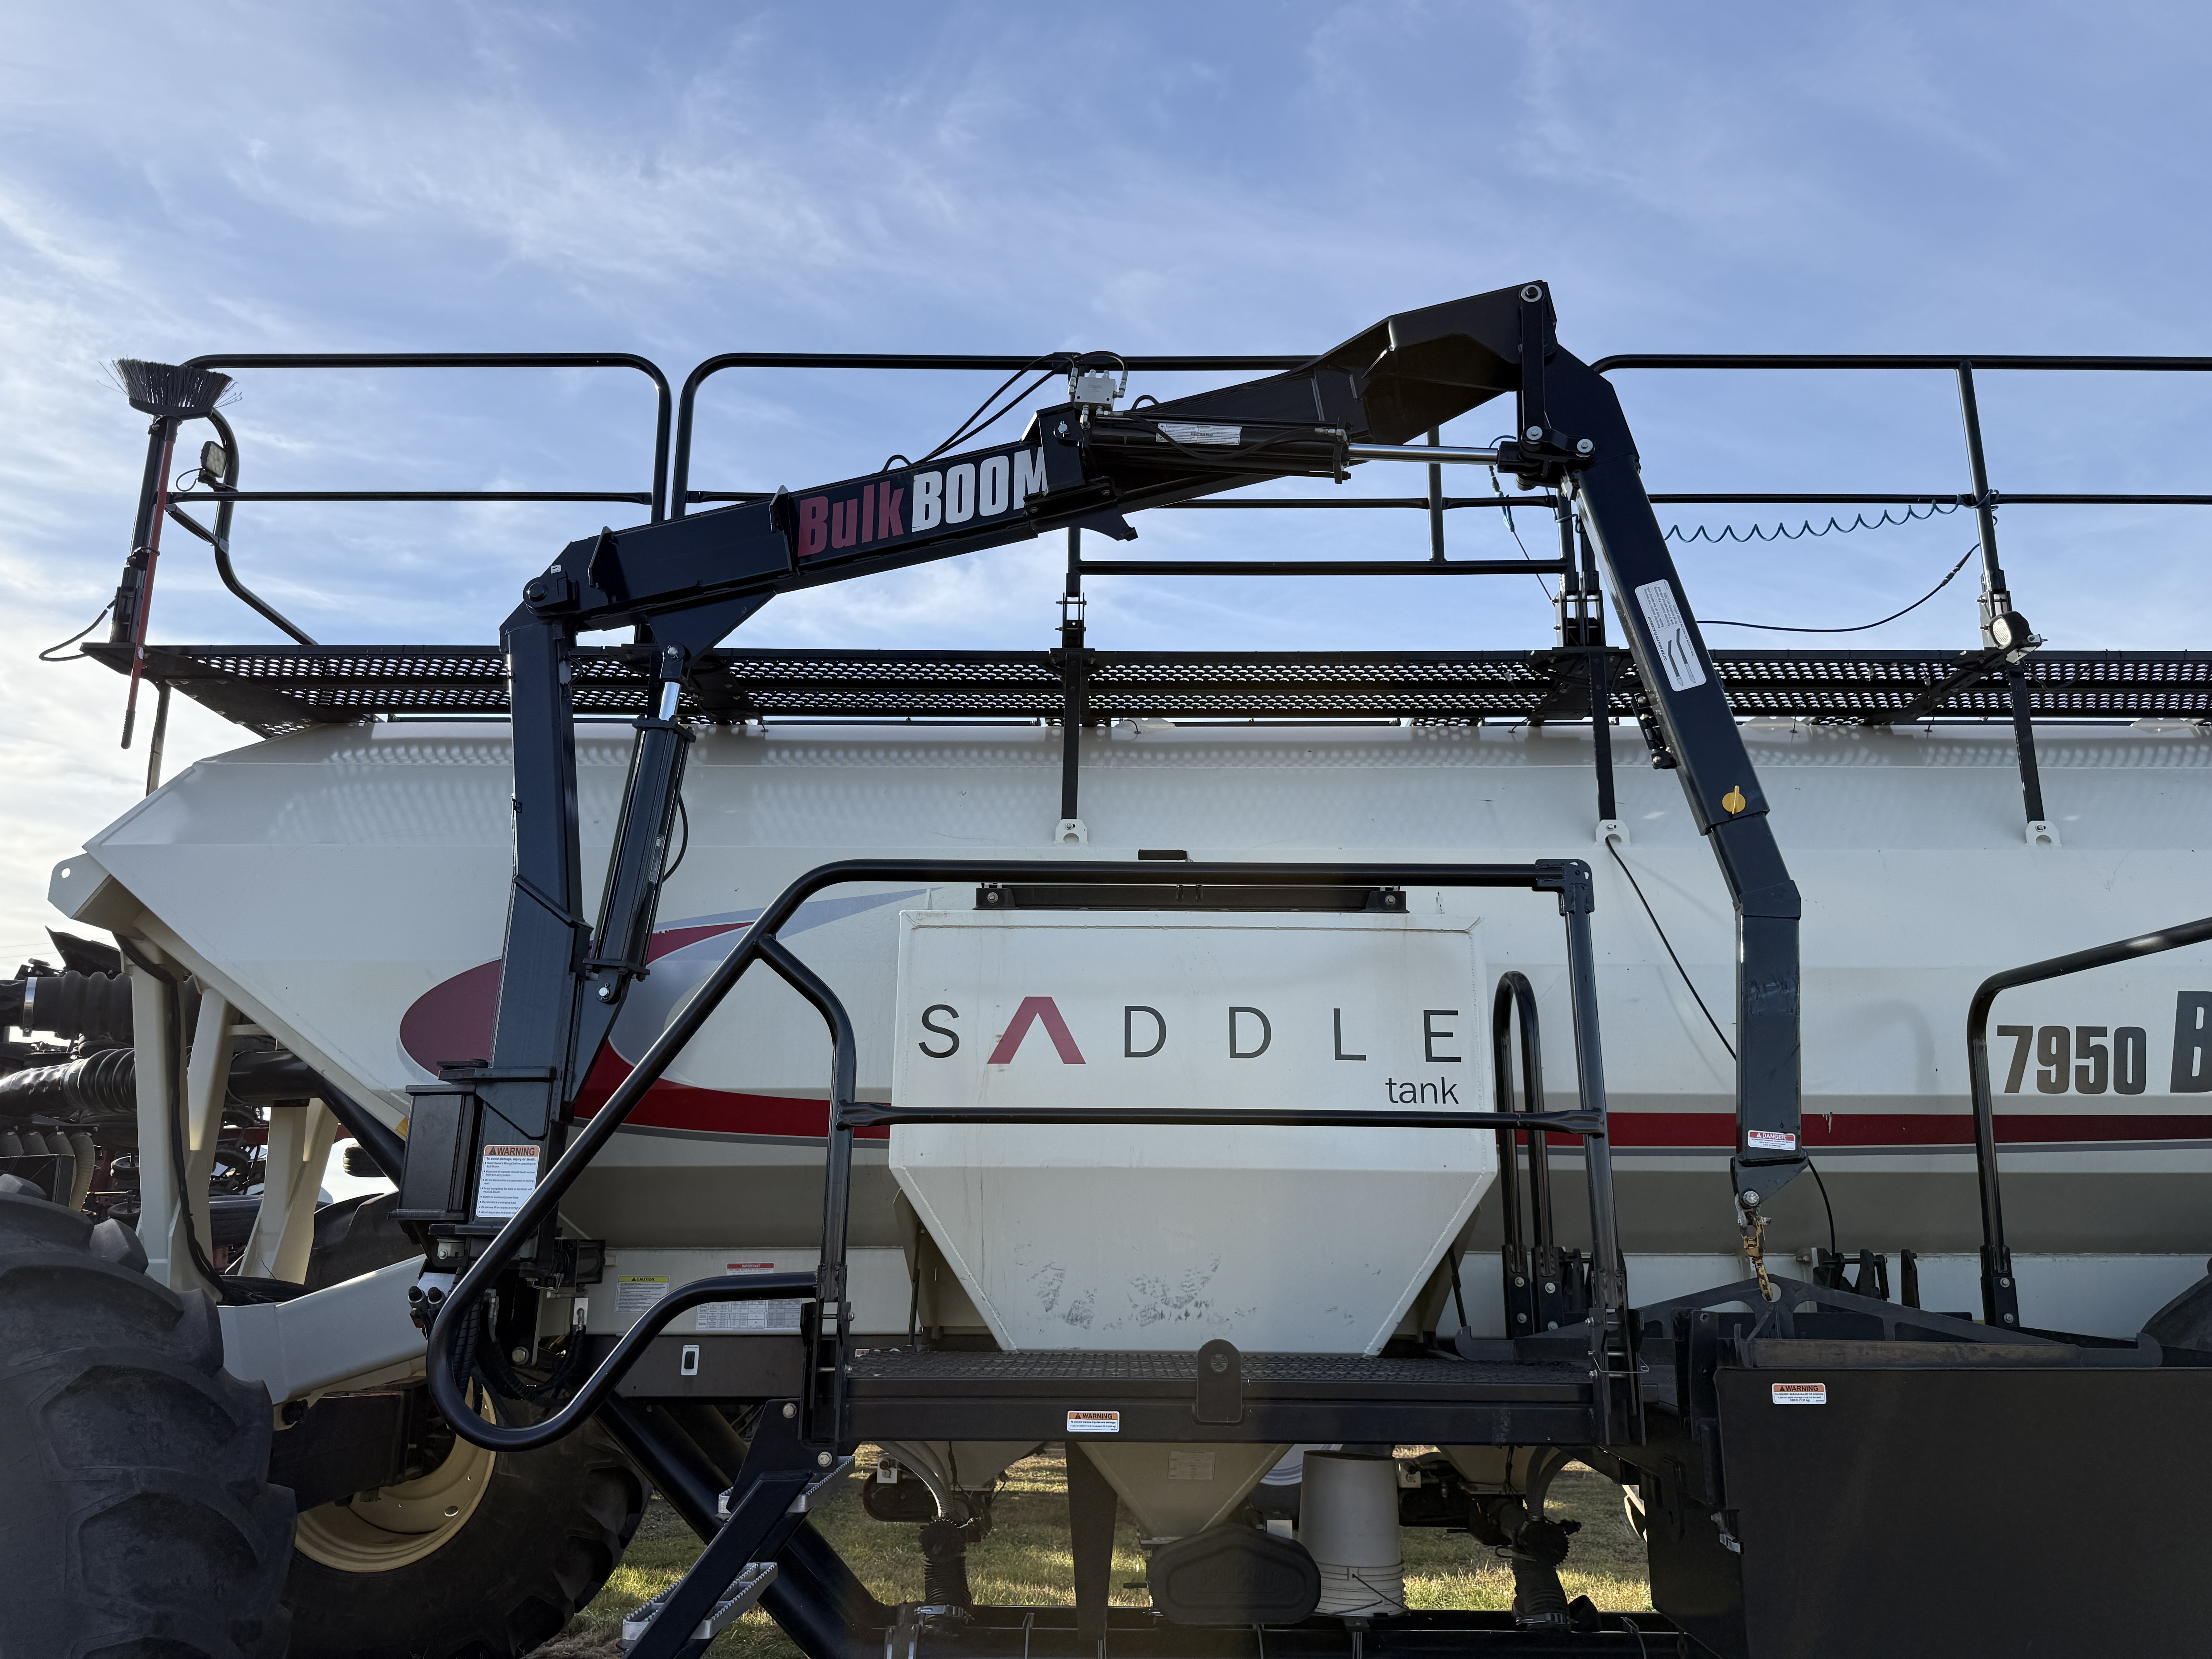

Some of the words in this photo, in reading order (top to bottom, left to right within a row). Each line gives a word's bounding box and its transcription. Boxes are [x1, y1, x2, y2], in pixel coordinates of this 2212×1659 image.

[798, 481, 904, 557] Bulk
[912, 447, 1047, 532] BOOM
[918, 996, 1461, 1064] SADDLE
[1997, 1025, 2146, 1094] 7950
[1385, 1077, 1458, 1104] tank
[498, 1147, 535, 1156] WARNING
